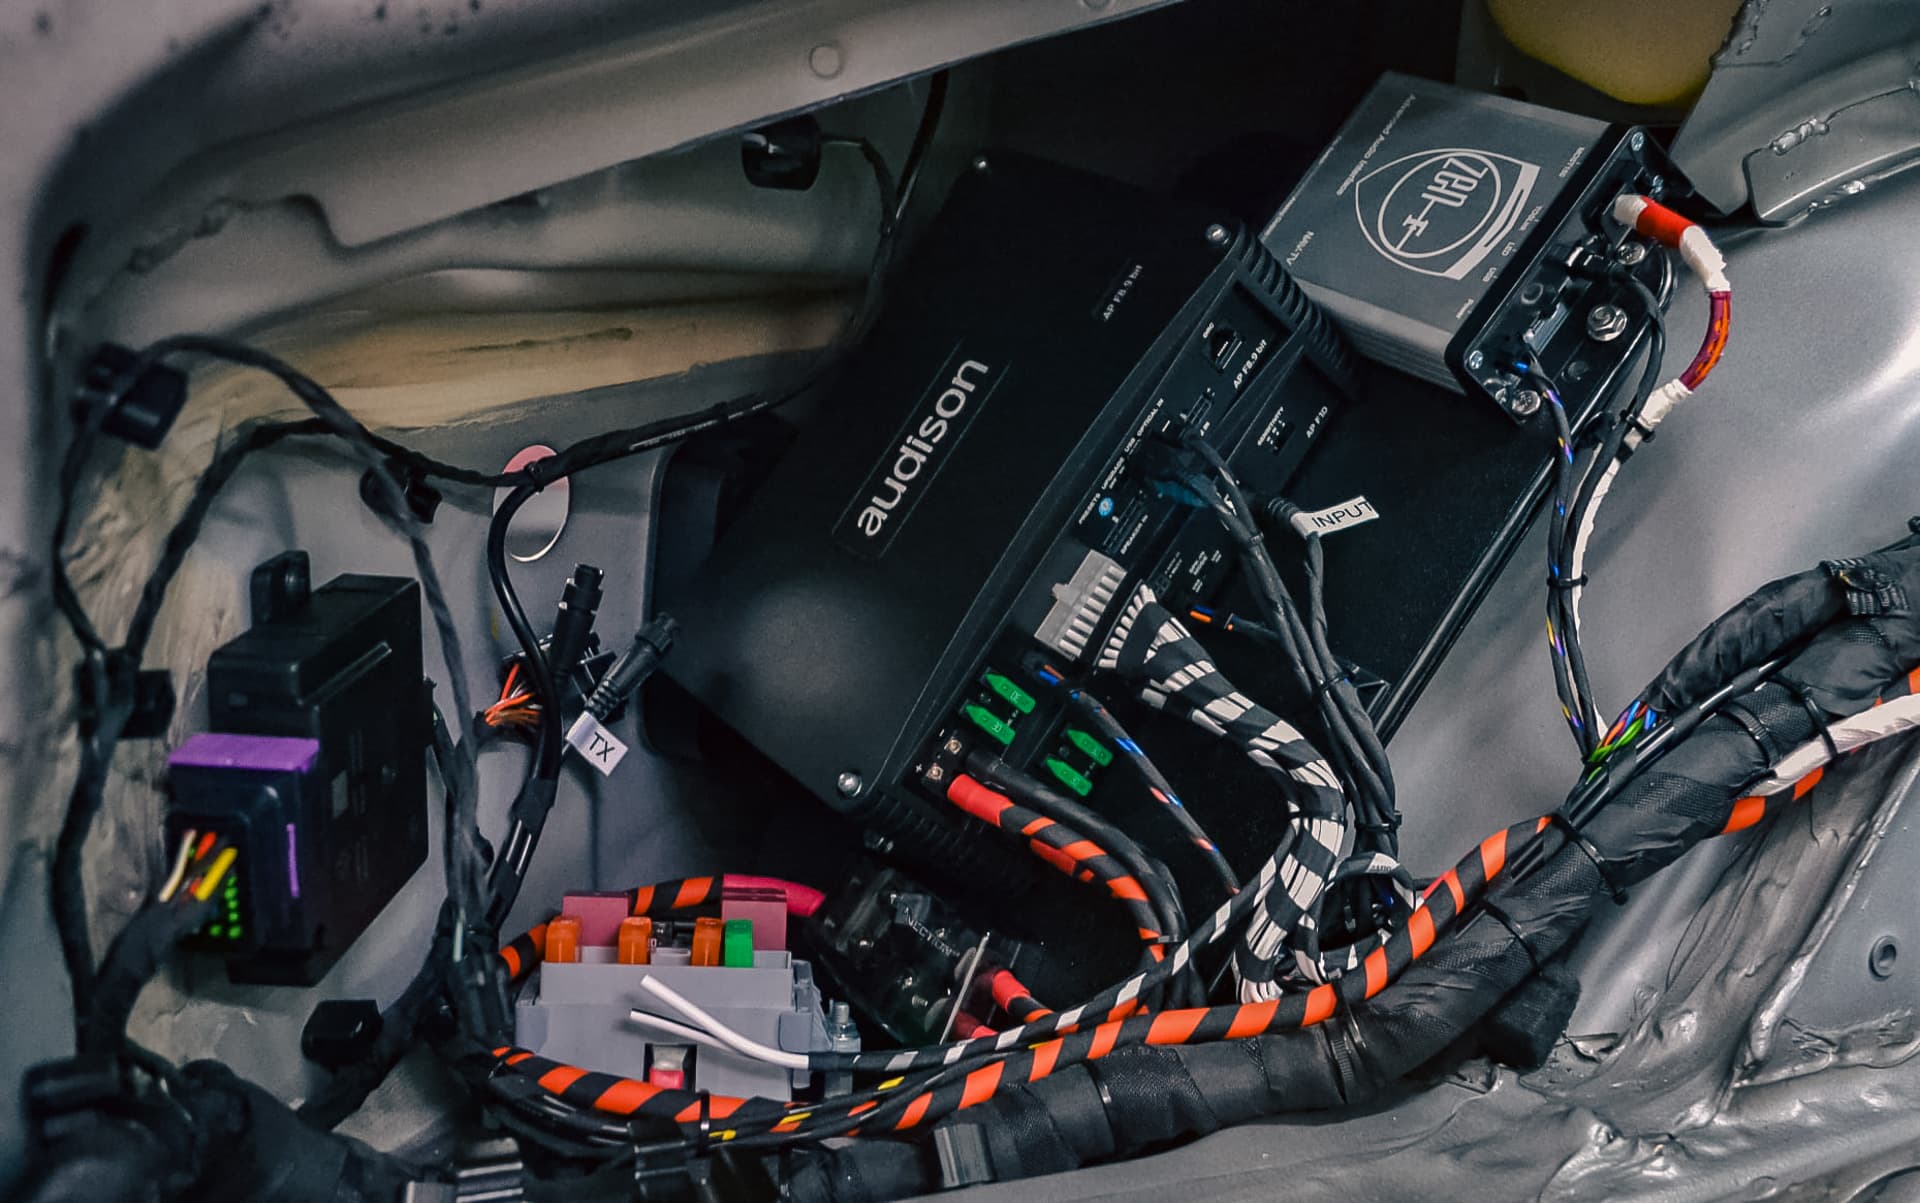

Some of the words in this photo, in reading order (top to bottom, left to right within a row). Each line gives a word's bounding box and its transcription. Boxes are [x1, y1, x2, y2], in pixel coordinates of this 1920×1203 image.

[1103, 304, 1114, 320] AP
[1233, 372, 1243, 389] AP
[1242, 352, 1258, 375] F8.9
[1255, 339, 1267, 354] bit
[1306, 423, 1316, 438] AP
[857, 359, 989, 537] audison
[1311, 500, 1373, 528] INPUT
[588, 730, 615, 763] TX
